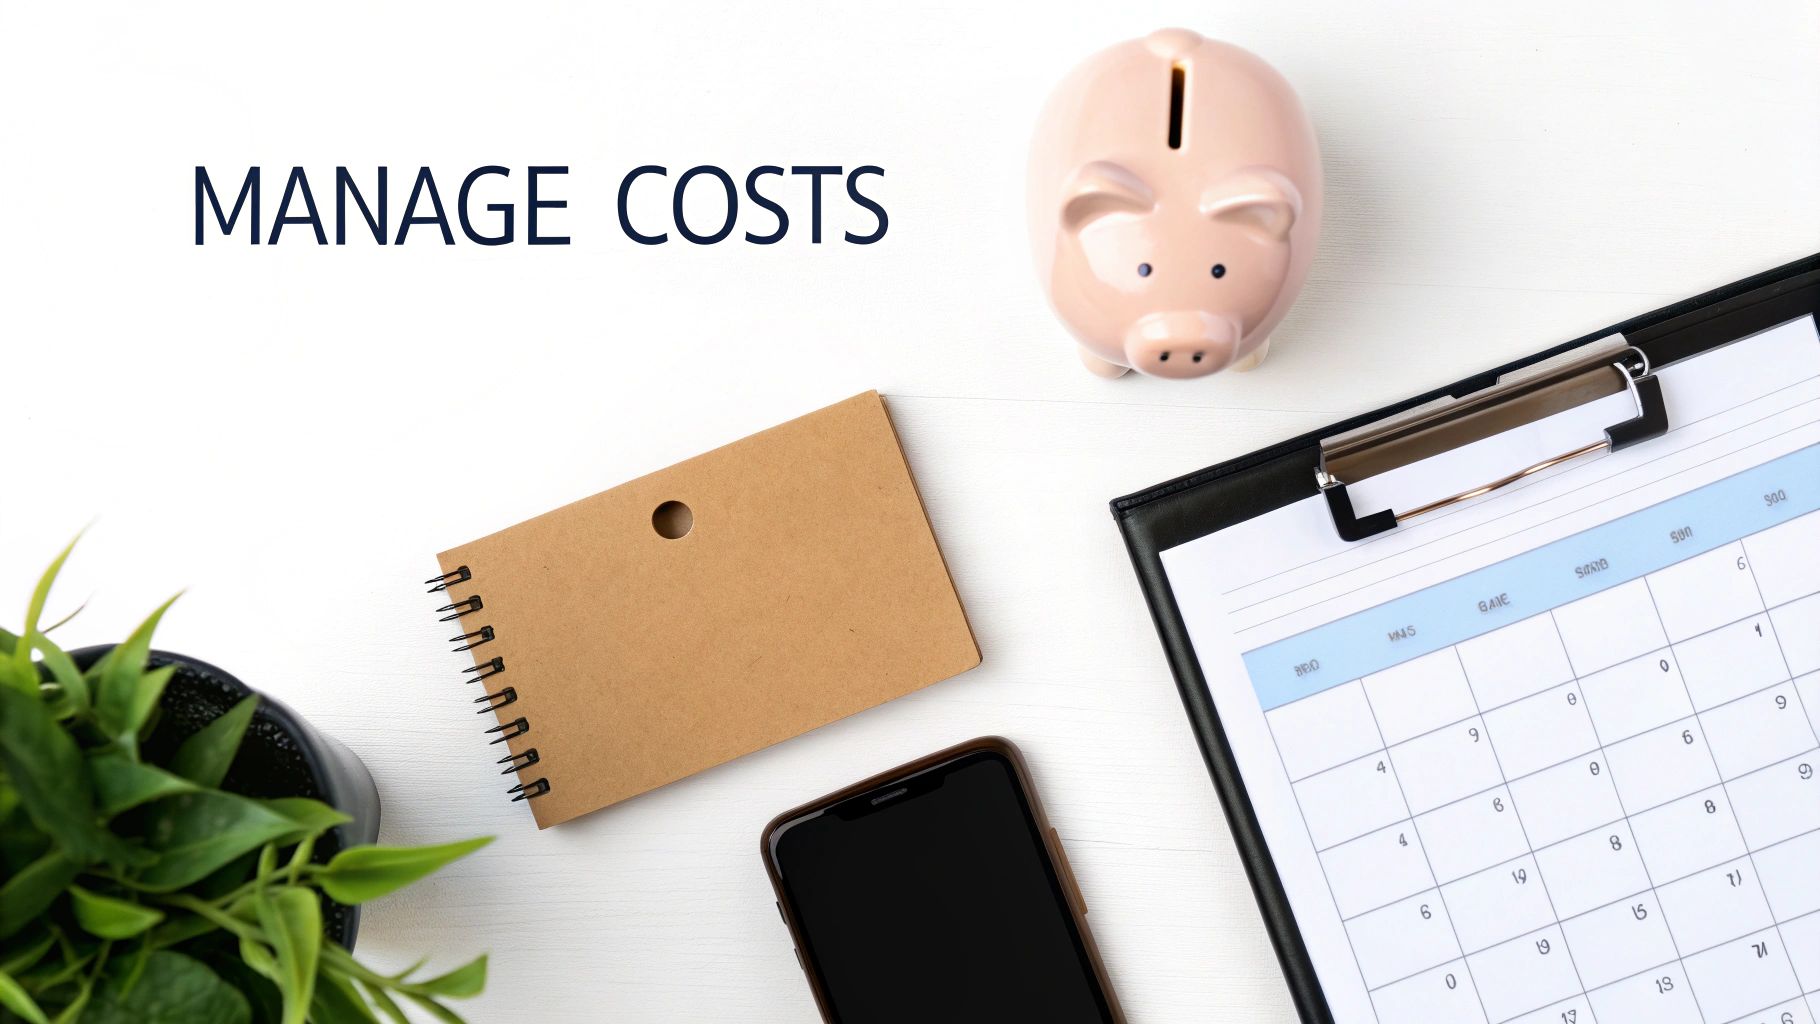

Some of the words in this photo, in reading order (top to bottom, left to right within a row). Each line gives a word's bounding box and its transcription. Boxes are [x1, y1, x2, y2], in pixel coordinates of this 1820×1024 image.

[1736, 556, 1746, 572] 6
[1376, 760, 1387, 774] 4
[1468, 727, 1480, 743] 9
[1659, 658, 1670, 673] 0
[1681, 729, 1694, 745] 6
[1774, 694, 1787, 710] 9
[1419, 903, 1432, 920] 6
[1608, 834, 1623, 852] 8
[1703, 799, 1717, 814] 8
[1445, 973, 1457, 990] 0
